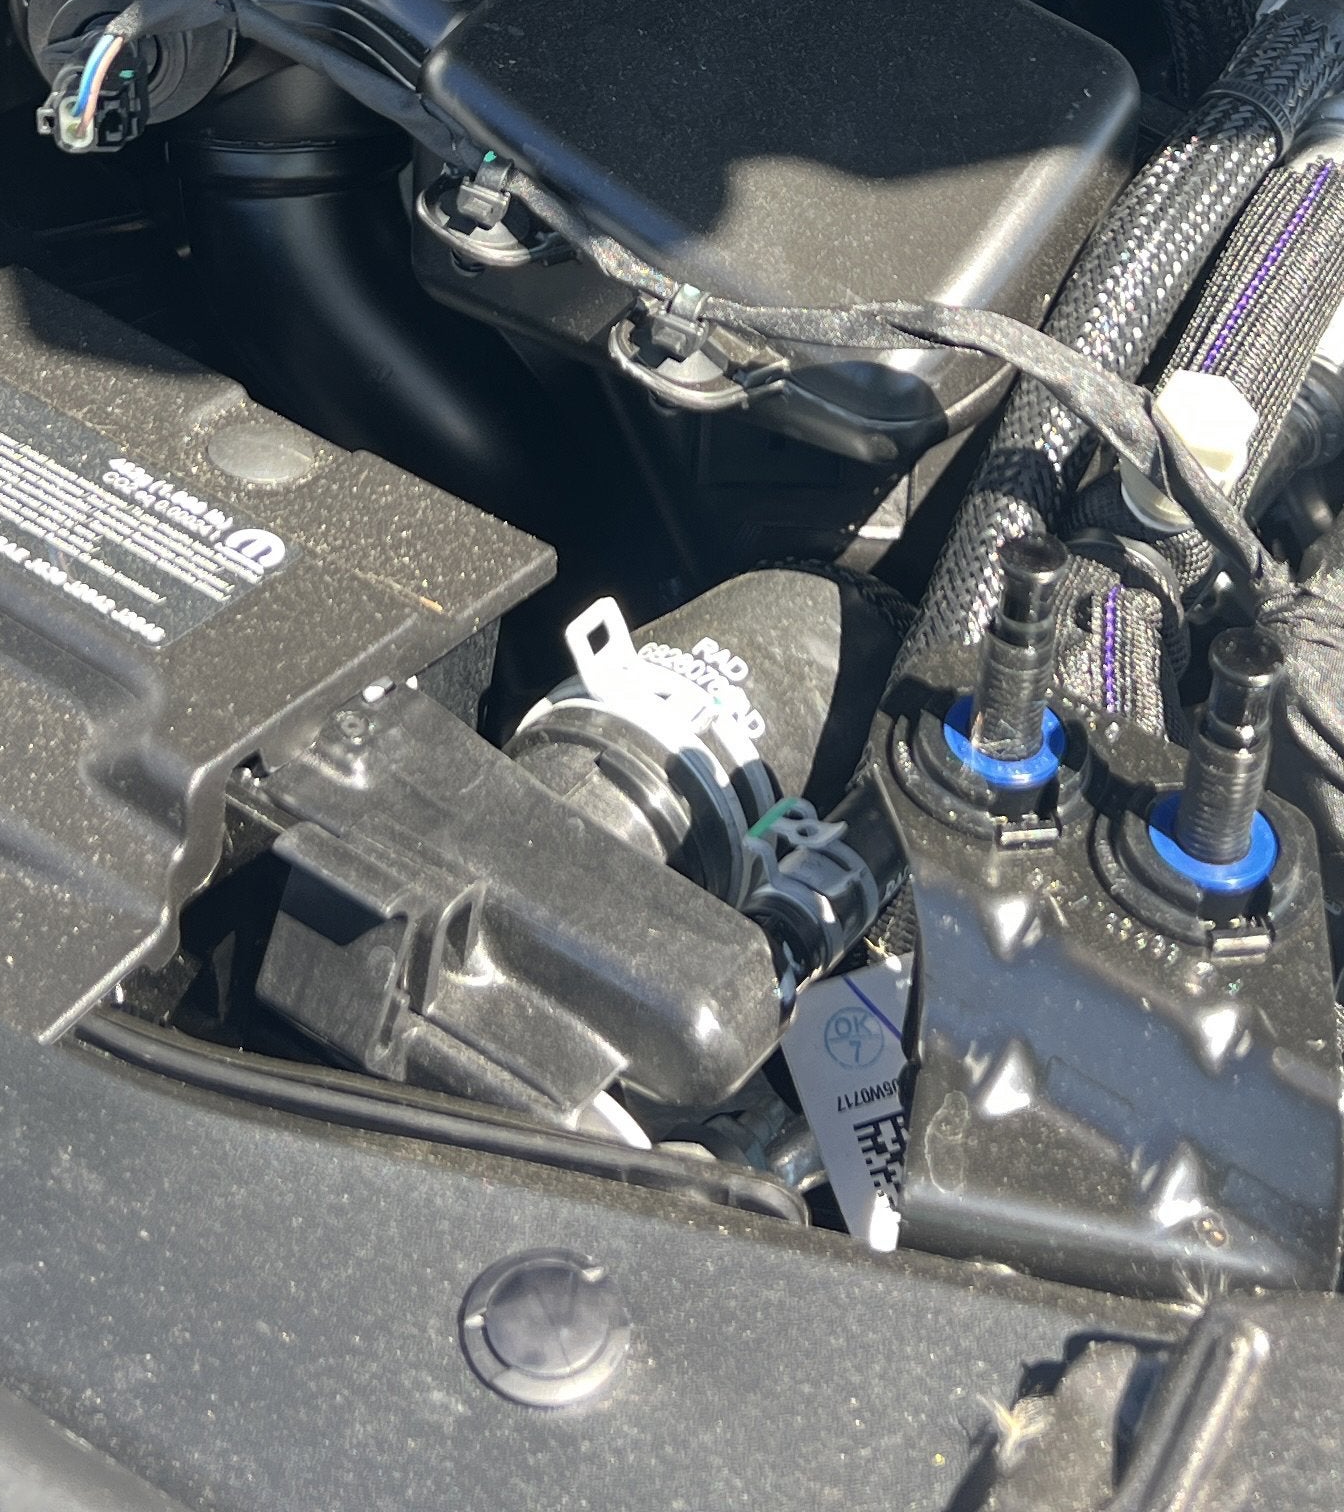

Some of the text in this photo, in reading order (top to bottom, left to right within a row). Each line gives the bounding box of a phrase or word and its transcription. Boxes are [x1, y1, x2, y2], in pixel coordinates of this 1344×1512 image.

[692, 637, 749, 681] RAD
[835, 1013, 872, 1037] OK
[849, 1040, 861, 1063] 7
